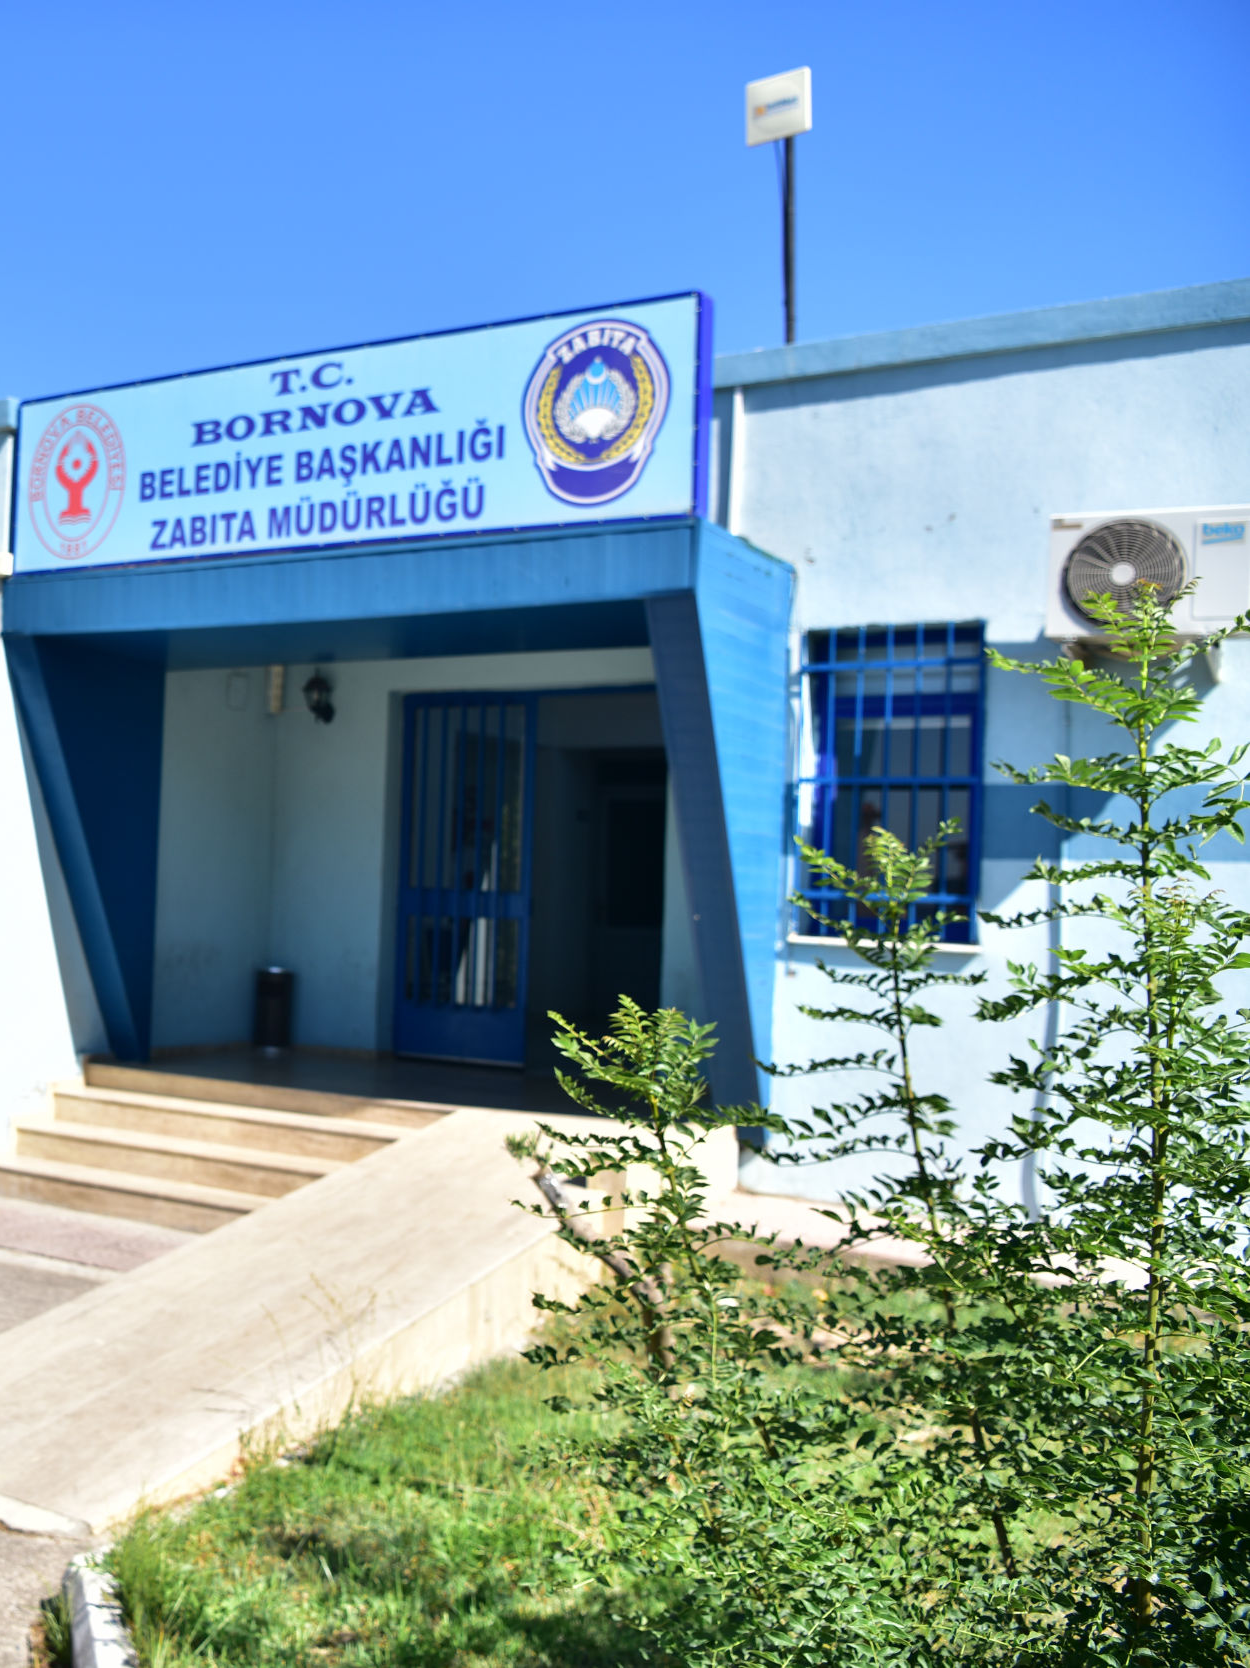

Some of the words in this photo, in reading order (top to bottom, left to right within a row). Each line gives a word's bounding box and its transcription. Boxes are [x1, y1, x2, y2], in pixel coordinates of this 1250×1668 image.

[556, 328, 637, 365] ZABITA
[271, 362, 354, 397] T.C.
[190, 387, 441, 448] BORNOVA
[139, 451, 284, 503] BELEDİYE
[295, 418, 506, 487] BAŞKANLIĞI
[150, 510, 256, 550] ZABITA
[268, 476, 485, 539] MÜDÜRLÜĞÜ
